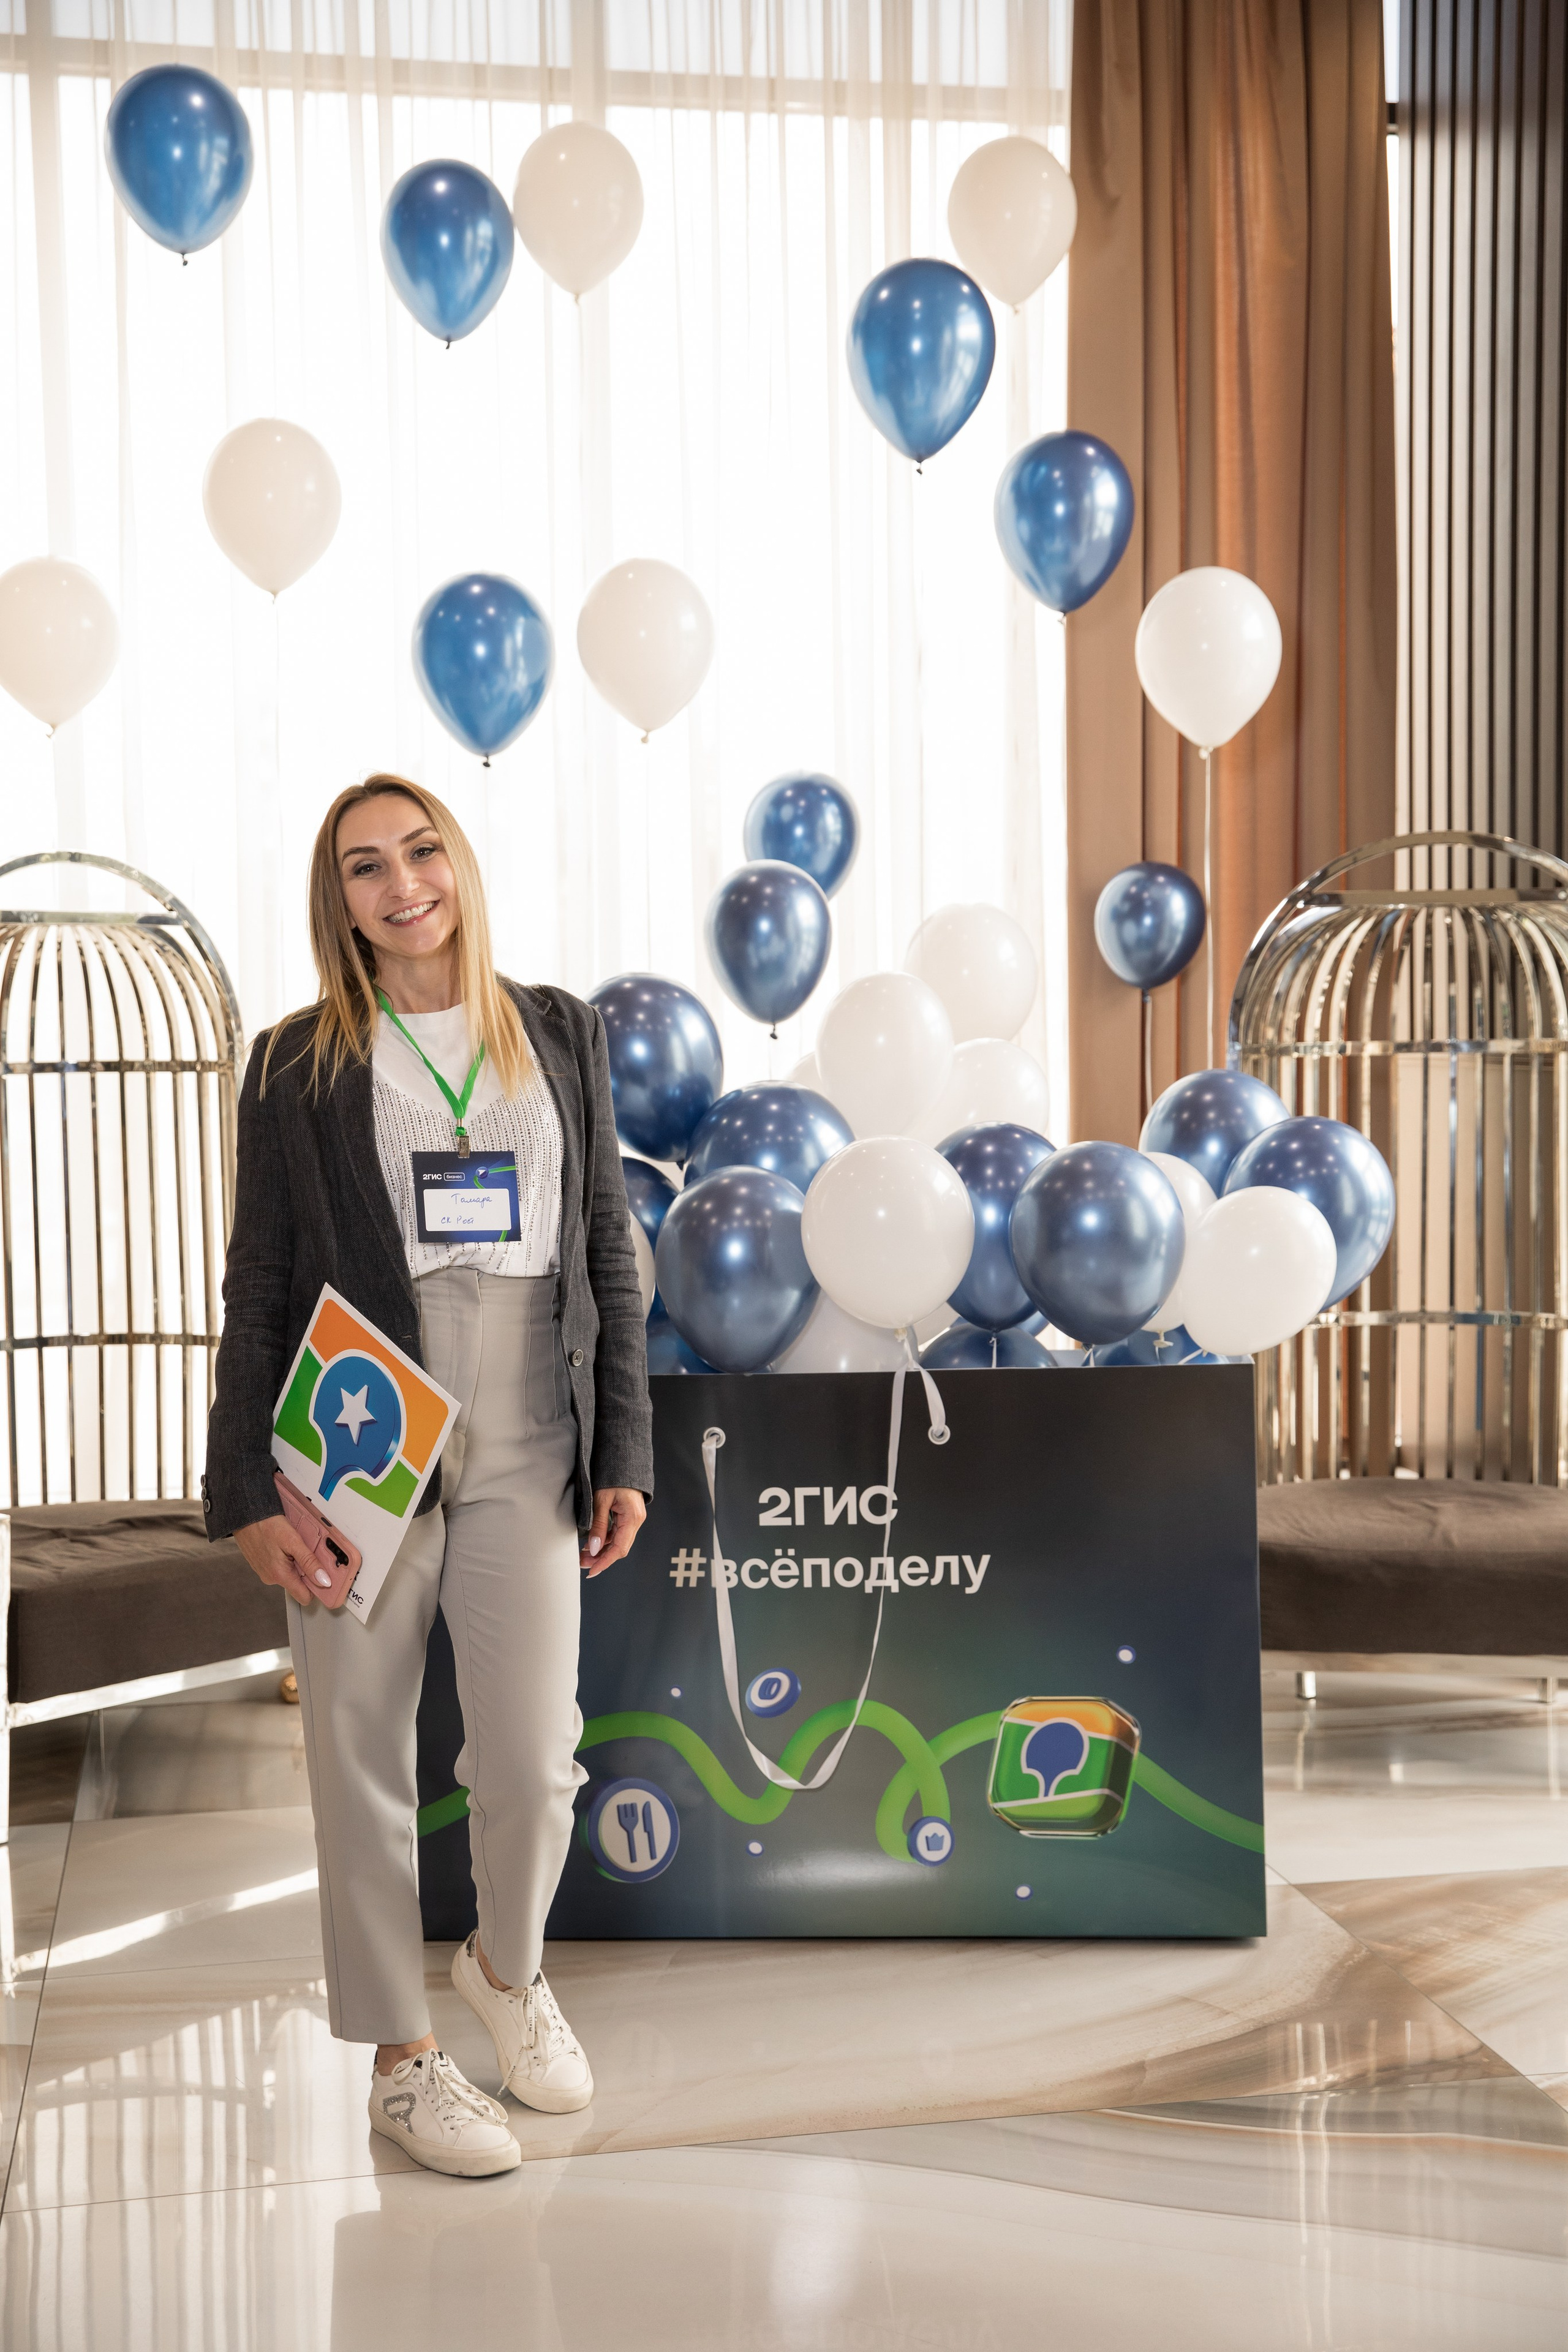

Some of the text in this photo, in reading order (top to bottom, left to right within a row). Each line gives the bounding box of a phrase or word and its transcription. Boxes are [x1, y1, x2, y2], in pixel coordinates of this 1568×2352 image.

[451, 1193, 492, 1208] Тамара
[758, 1485, 899, 1526] 2ГИС
[669, 1548, 992, 1594] #всёподелу
[348, 1588, 364, 1605] ГИС
